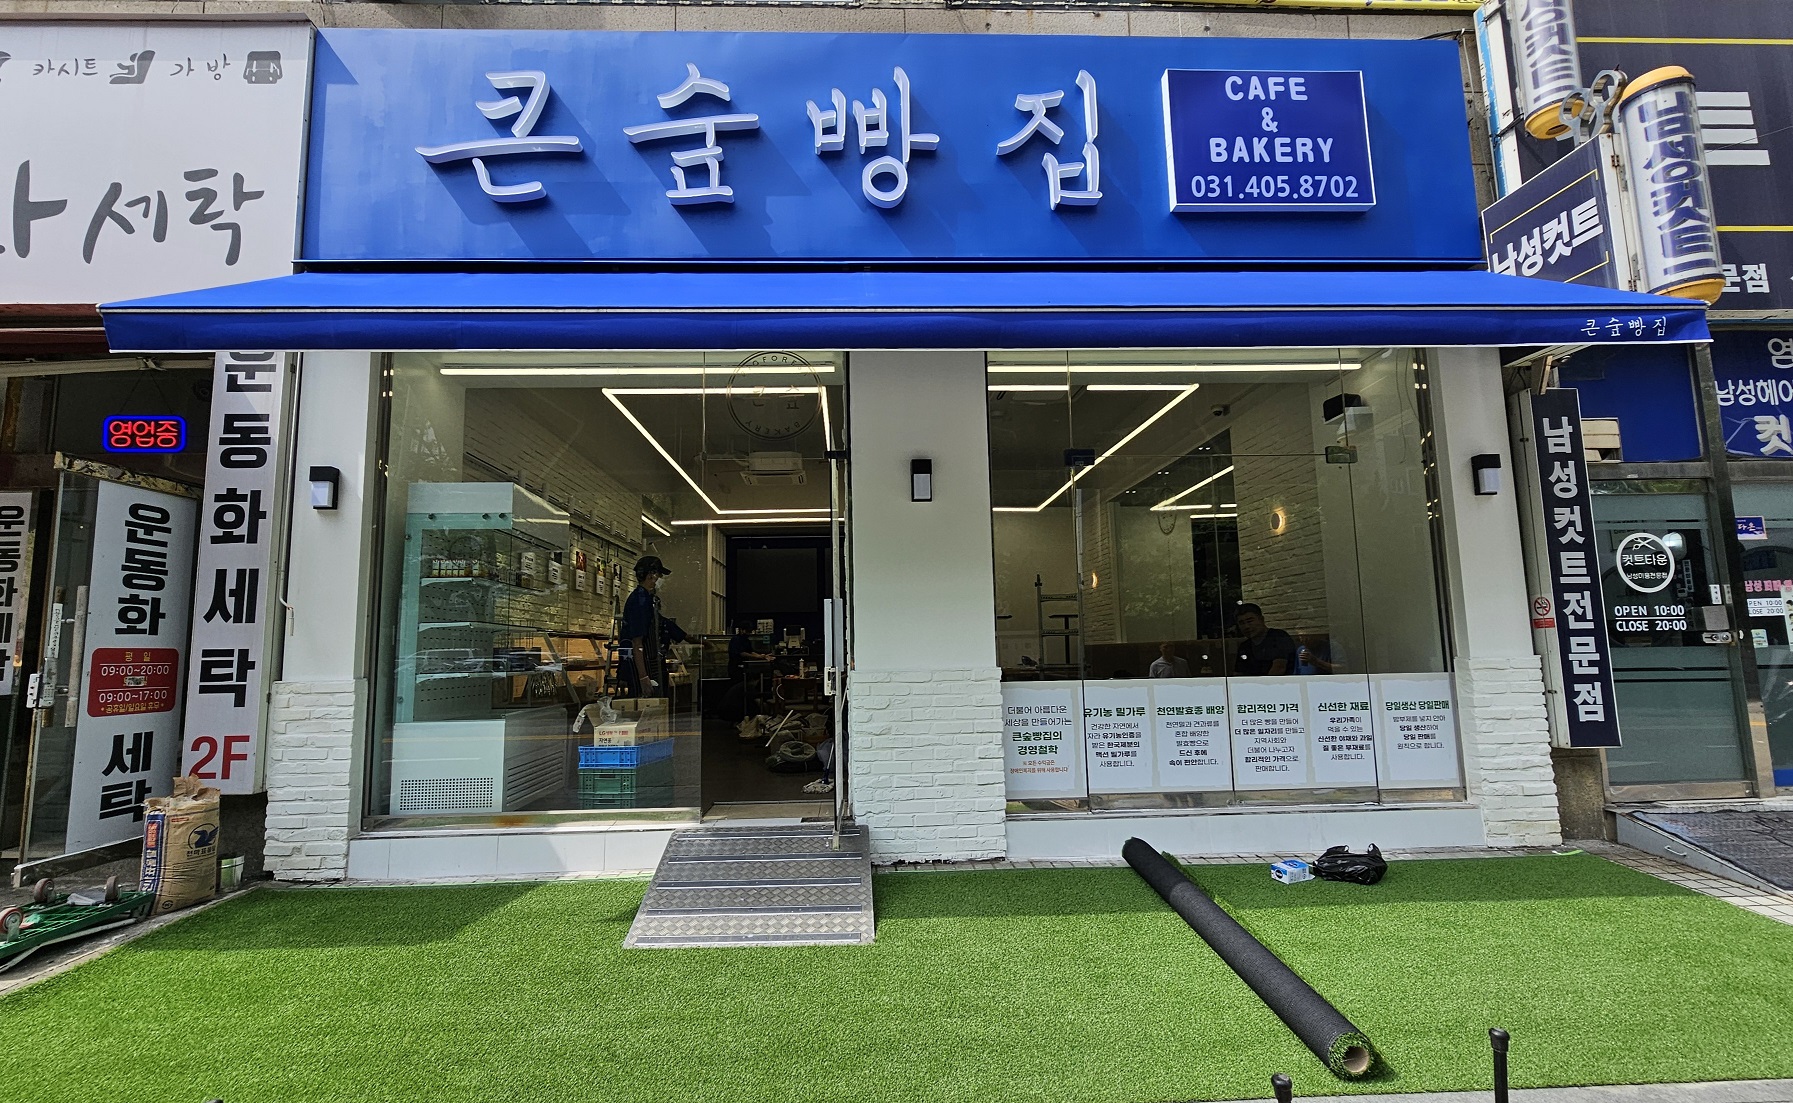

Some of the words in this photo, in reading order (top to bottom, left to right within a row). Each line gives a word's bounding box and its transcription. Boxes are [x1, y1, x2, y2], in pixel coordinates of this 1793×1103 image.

[33, 58, 98, 76] 카시트
[1225, 75, 1308, 101] CAFE
[1261, 106, 1279, 133] &
[1209, 136, 1333, 163] BAKERY
[1191, 175, 1359, 199] 031.405.8702
[109, 420, 179, 448] 영업중
[1622, 554, 1668, 566] 컷트타운
[115, 503, 172, 636] 운동화
[1543, 416, 1605, 722] 남성컷트전문점
[1614, 605, 1648, 616] OPEN
[1654, 604, 1685, 616] 10:00
[1616, 620, 1649, 631] CLOSE
[1655, 620, 1687, 631] 20:00
[101, 665, 169, 676] 09:00~20:00
[99, 690, 168, 703] 09:00~17:00
[1007, 706, 1032, 715] 더불어
[1034, 705, 1067, 714] 아름다운
[1156, 706, 1203, 716] 천연발효종
[1206, 705, 1225, 715] 배양
[1236, 704, 1276, 714] 합리적인
[1279, 703, 1299, 713] 가격
[1318, 702, 1347, 712] 신선한
[1350, 701, 1370, 711] 재료
[1385, 701, 1417, 711] 당일생산
[1418, 700, 1450, 710] 당일판매
[1084, 708, 1113, 718] 유기농
[1116, 707, 1146, 716] 밀가루
[1005, 718, 1029, 727] 세상을
[1031, 717, 1072, 726] 만들어가는
[1112, 722, 1139, 730] 자연에서
[1012, 731, 1063, 742] 큰숲빵집의
[1017, 745, 1059, 755] 경영철학
[190, 735, 251, 781] 2F
[1331, 753, 1365, 761] 사용합니다.
[99, 730, 153, 823] 세탁
